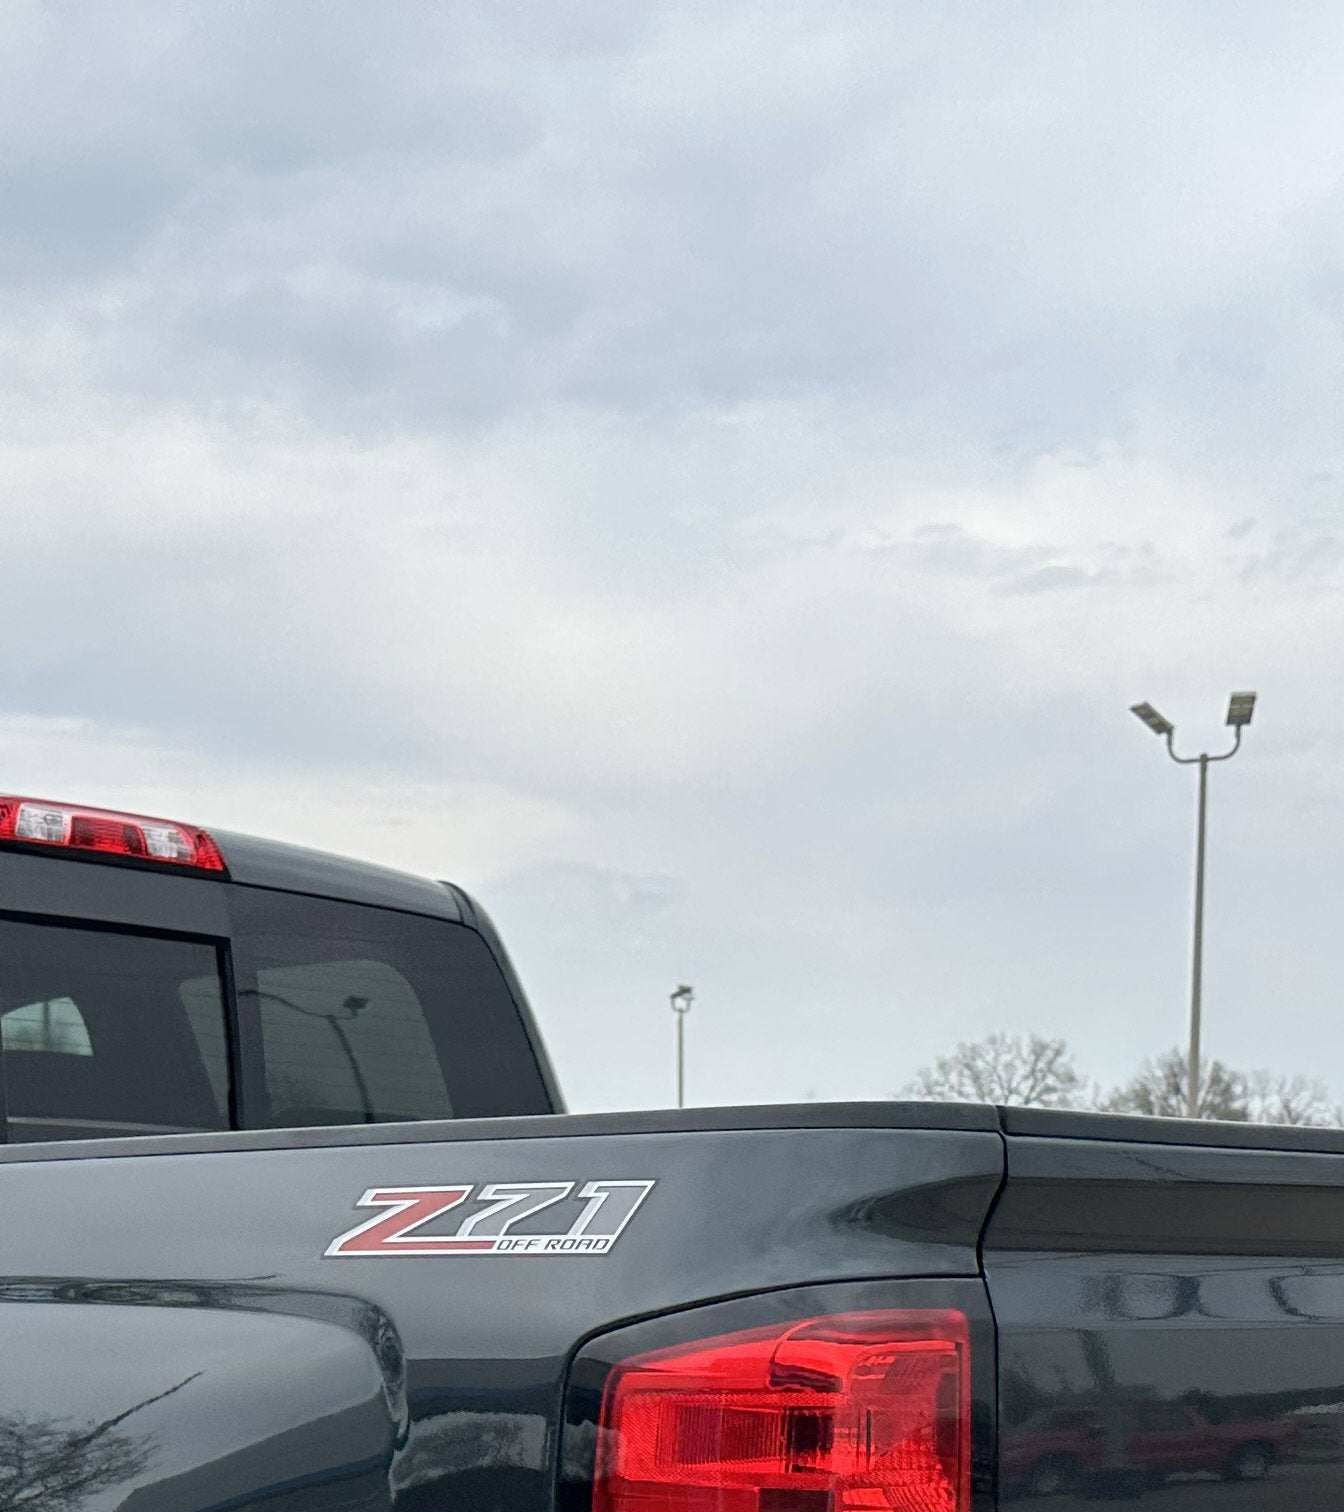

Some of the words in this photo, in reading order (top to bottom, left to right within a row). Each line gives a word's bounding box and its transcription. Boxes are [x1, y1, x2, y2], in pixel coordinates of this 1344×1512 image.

[324, 1179, 657, 1257] Z71
[496, 1238, 541, 1251] OFF
[544, 1238, 611, 1251] ROAD
